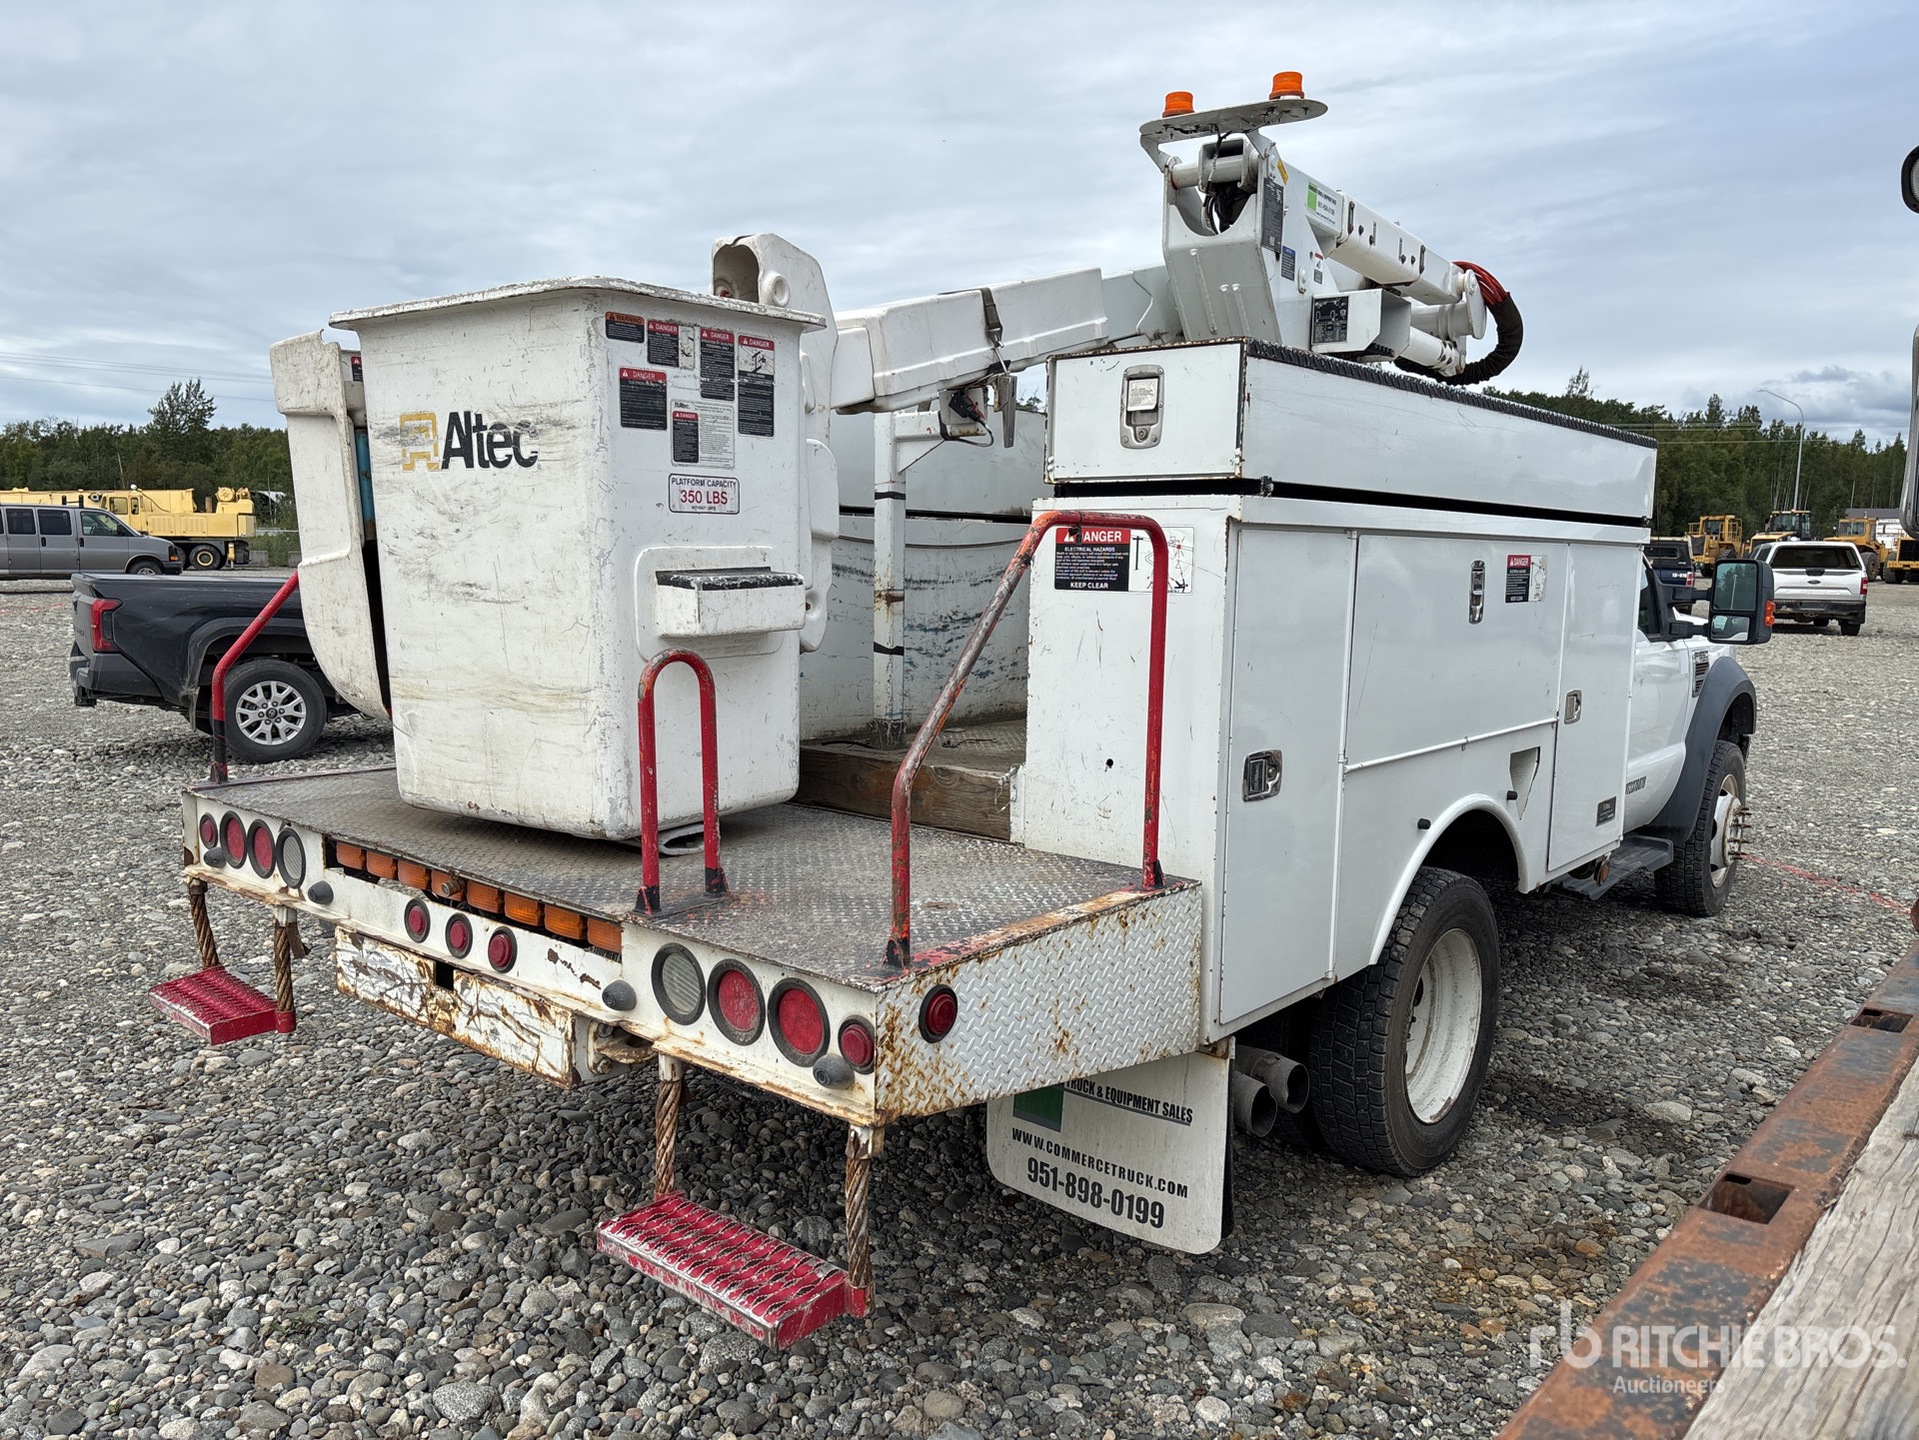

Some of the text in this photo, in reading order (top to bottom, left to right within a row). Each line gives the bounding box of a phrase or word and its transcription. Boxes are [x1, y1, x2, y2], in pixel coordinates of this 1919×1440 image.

[655, 323, 678, 334] DANGER
[710, 331, 730, 340] DANGER
[749, 339, 769, 348] DANGER
[632, 371, 656, 381] DANGER
[440, 410, 539, 470] Altec
[671, 477, 736, 488] PLATFORM CAPACITY
[680, 489, 728, 505] 350 LBS
[1078, 531, 1122, 542] ANGER
[1066, 1078, 1193, 1123] TRUCK & EQUIPMENT SALES
[1012, 1127, 1188, 1199] WWW.COMMERCETRUCK.COM
[1027, 1157, 1165, 1229] 951-898-0199
